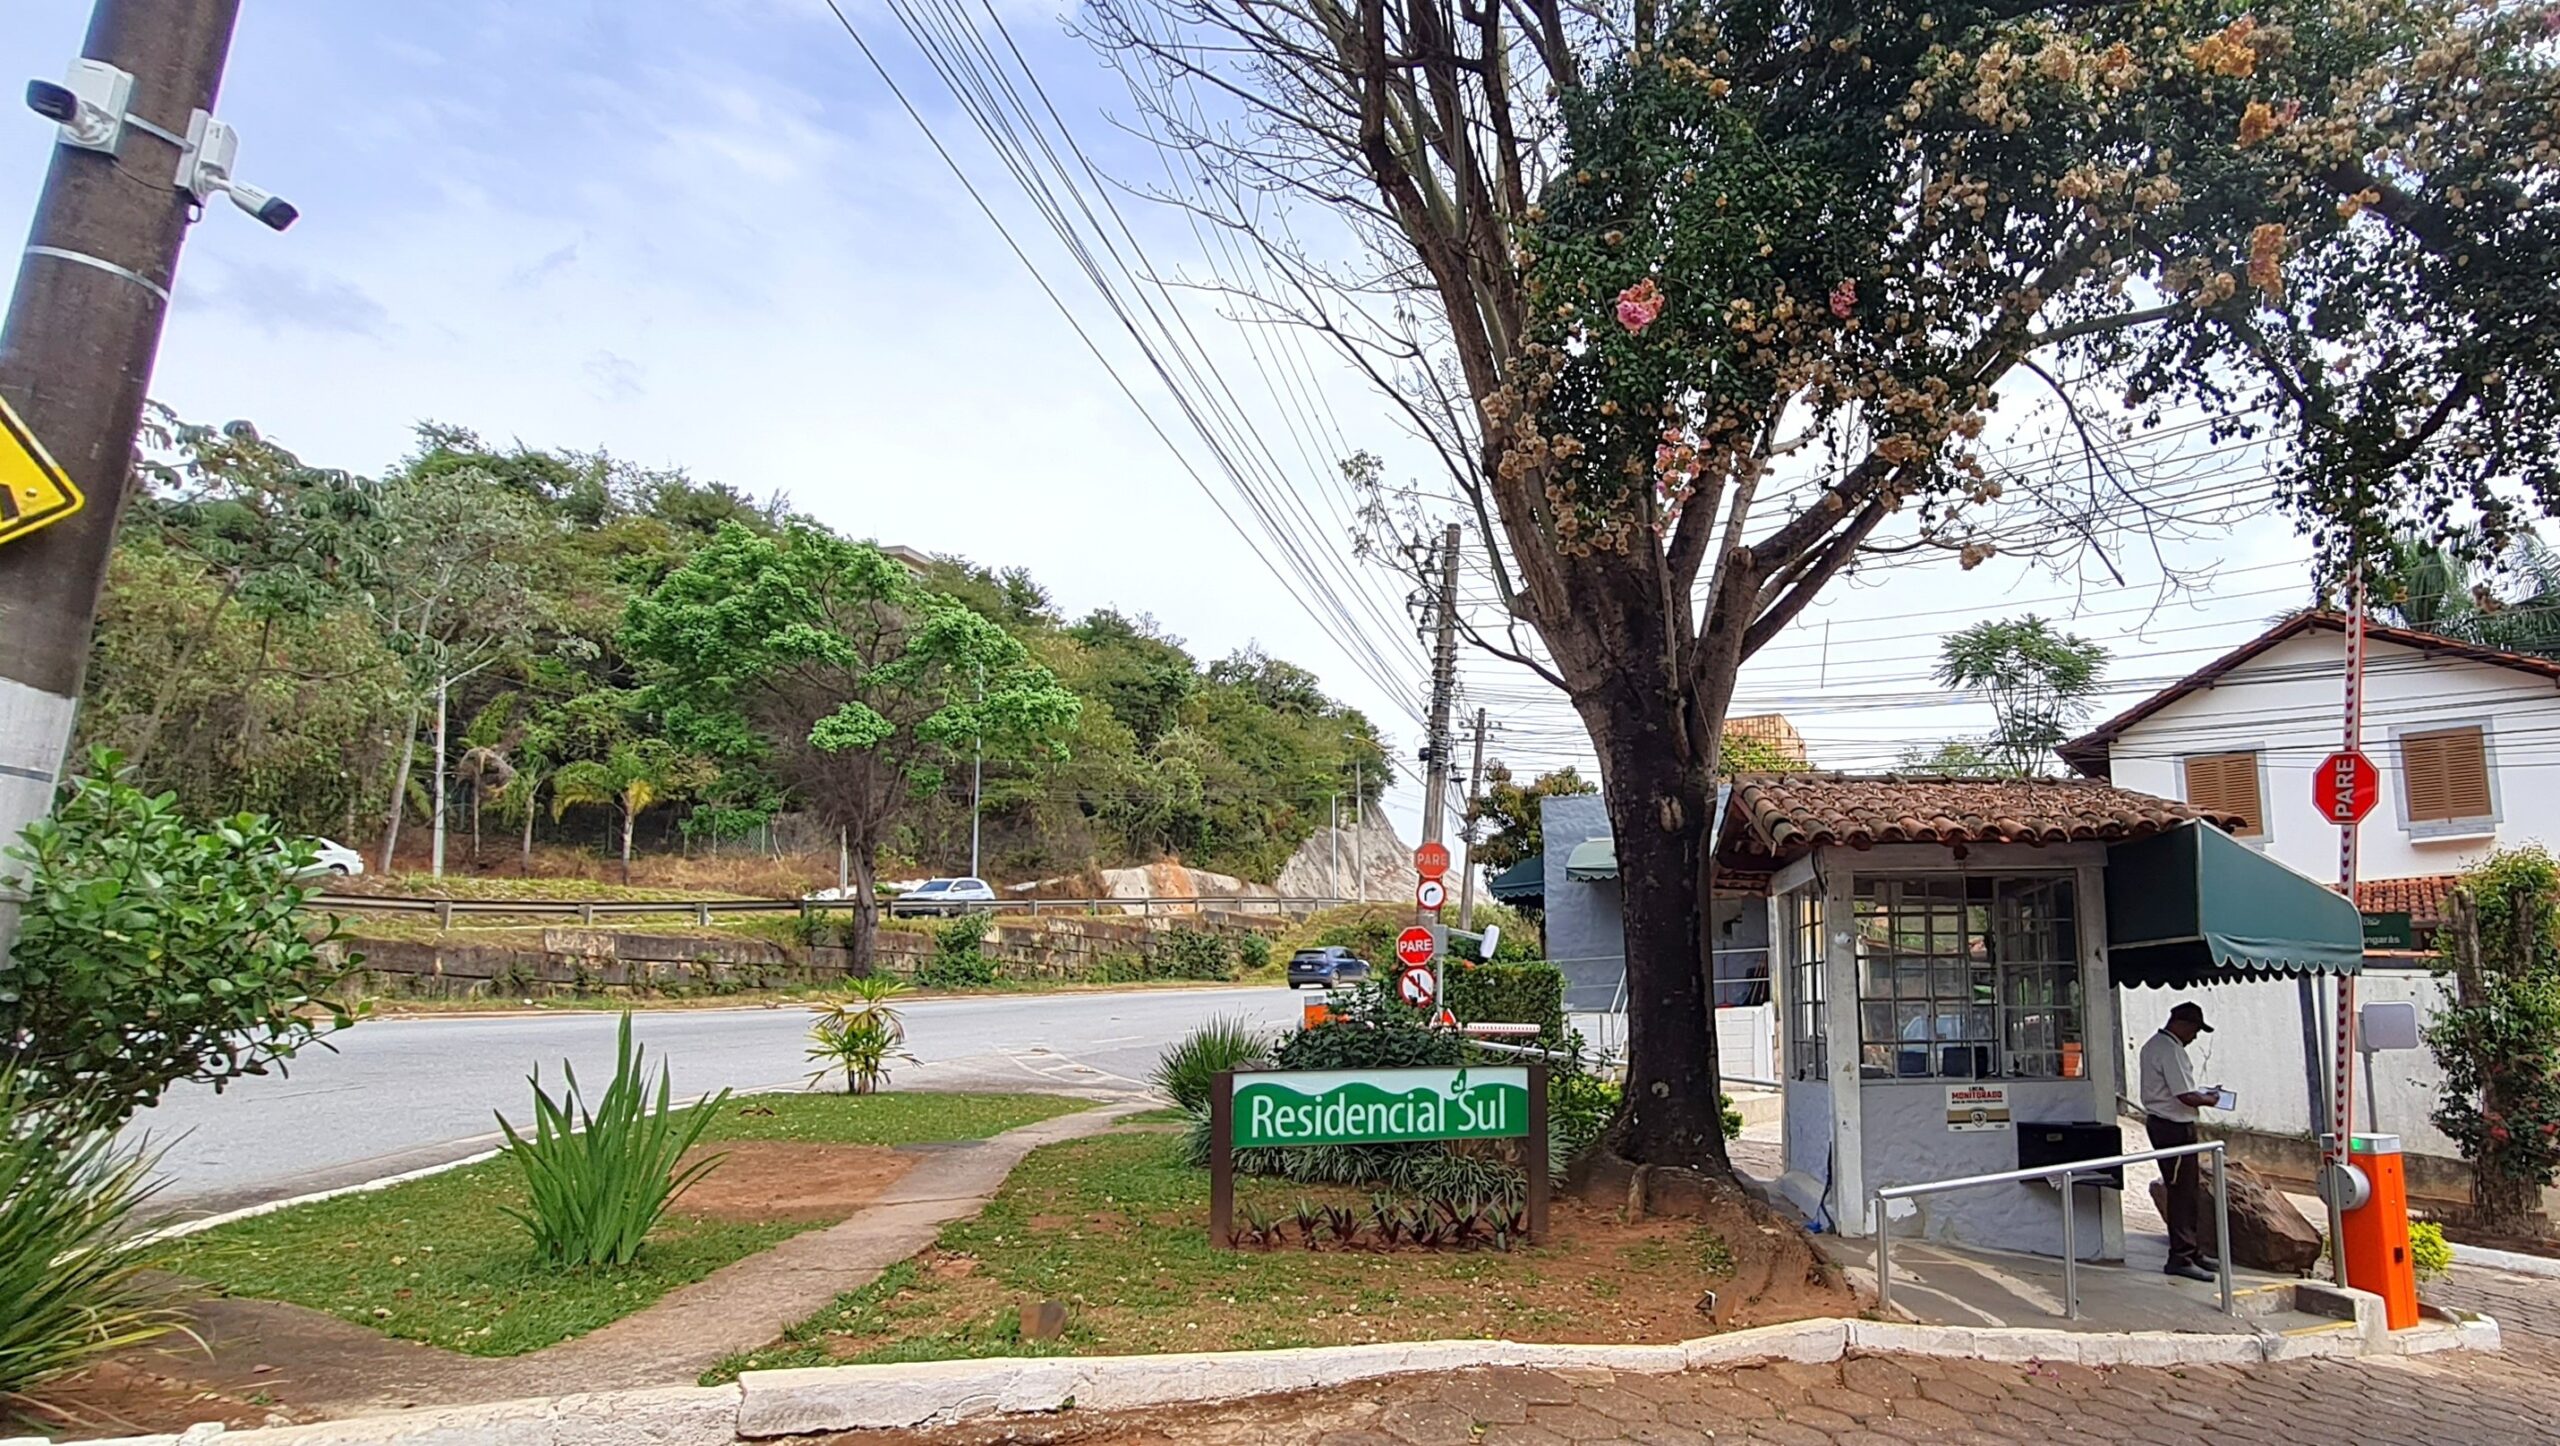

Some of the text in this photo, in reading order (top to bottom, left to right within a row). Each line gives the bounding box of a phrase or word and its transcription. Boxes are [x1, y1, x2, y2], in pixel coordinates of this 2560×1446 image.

[2335, 758, 2355, 817] PARE
[1417, 853, 1447, 866] PARE
[1400, 938, 1433, 952] PARE
[1952, 1091, 2003, 1099] MONITORADO
[1251, 1088, 1505, 1138] Residencial Sul
